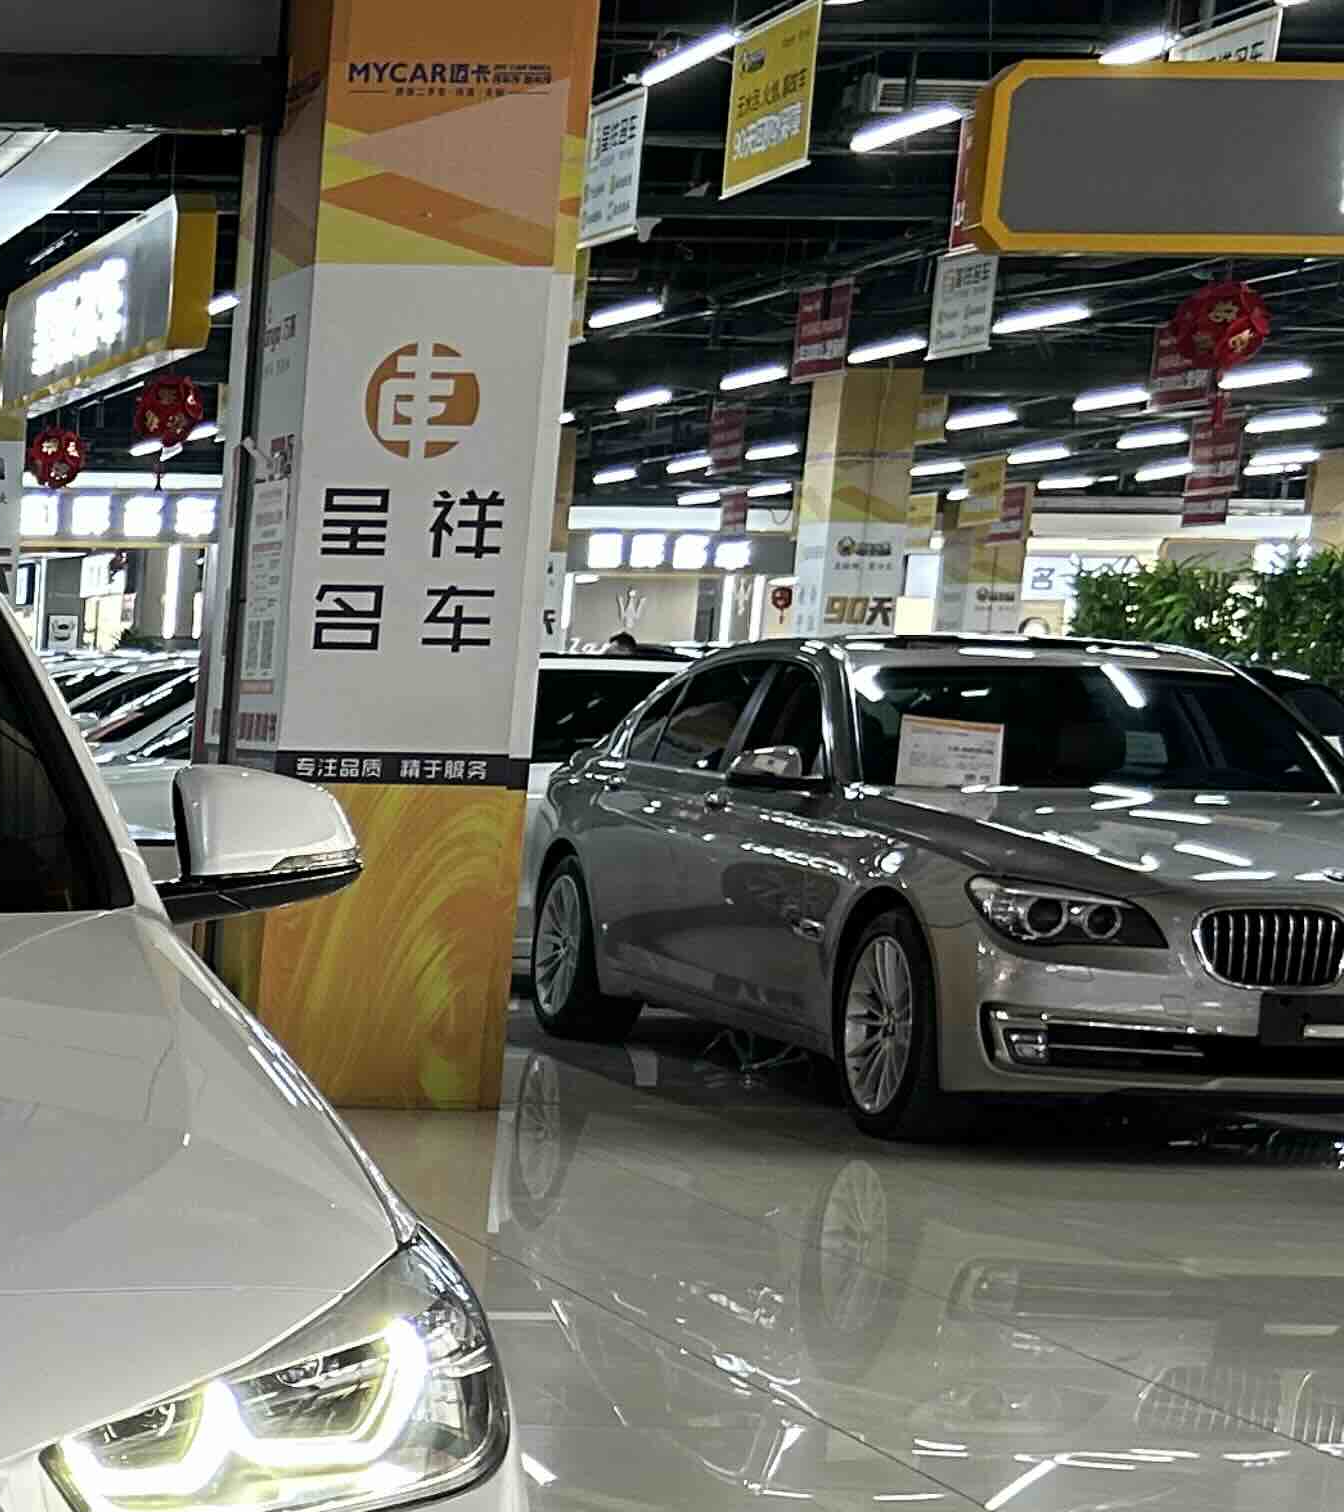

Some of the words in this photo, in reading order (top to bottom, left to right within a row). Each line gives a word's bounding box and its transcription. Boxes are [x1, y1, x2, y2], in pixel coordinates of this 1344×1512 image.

[321, 488, 505, 559] 呈祥
[313, 583, 496, 653] 名车
[823, 597, 894, 627] 90天
[296, 757, 384, 779] 专注品质
[400, 758, 489, 781] 精于服务
